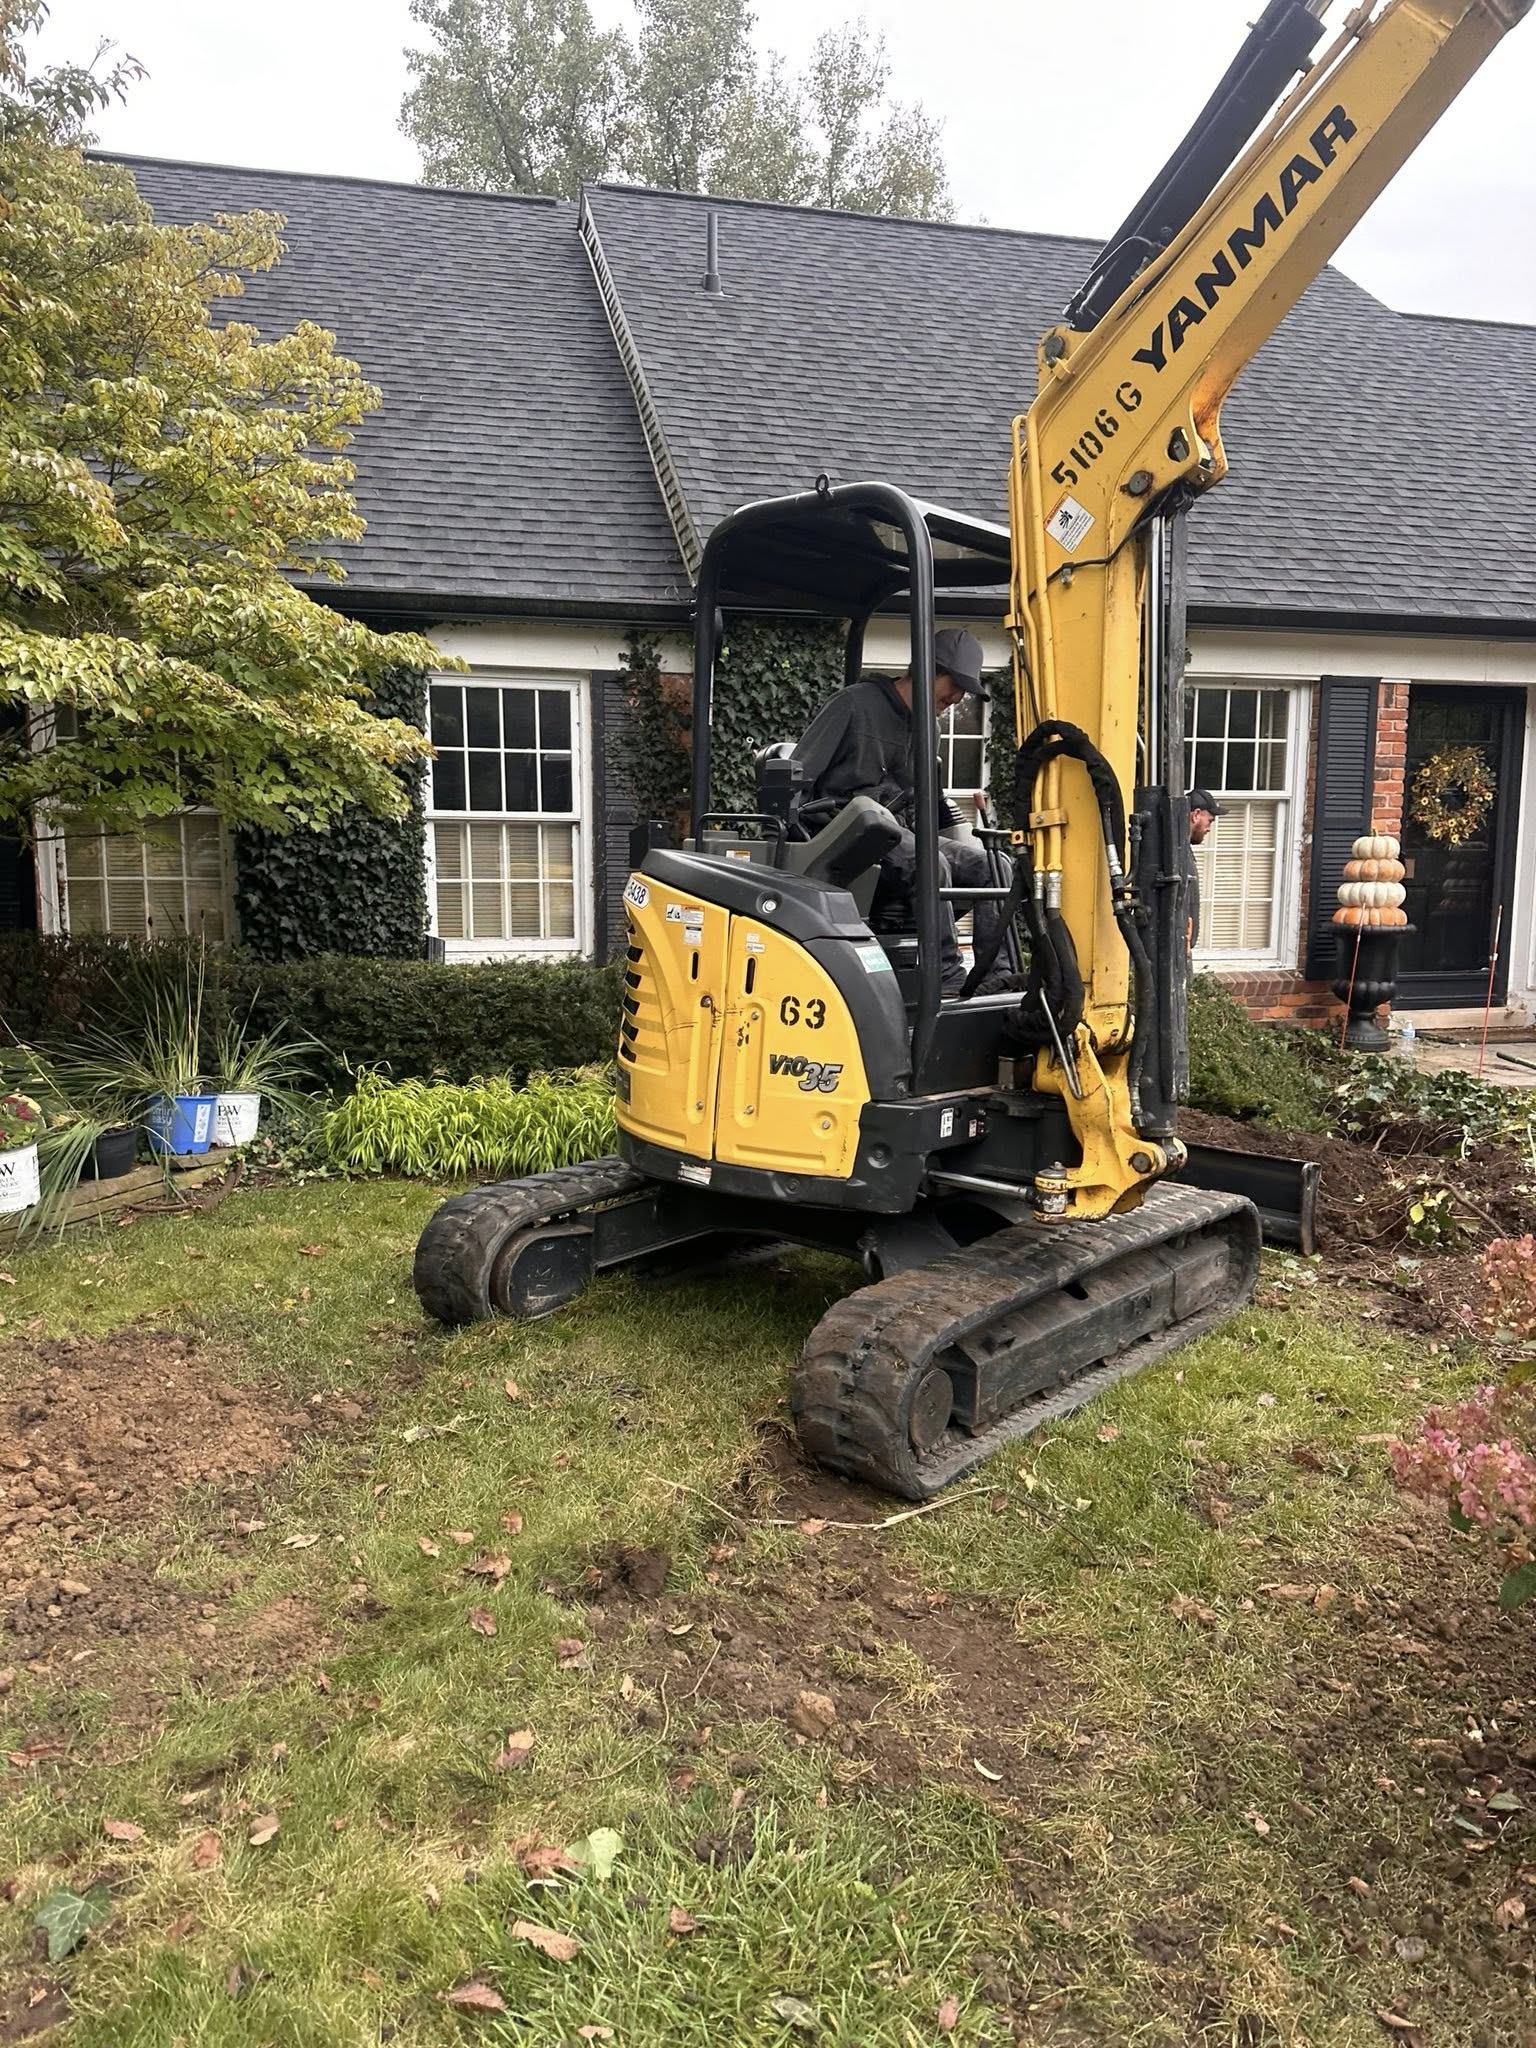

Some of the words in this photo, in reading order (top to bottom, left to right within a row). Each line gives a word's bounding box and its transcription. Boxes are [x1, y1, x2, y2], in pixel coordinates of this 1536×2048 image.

[1131, 104, 1358, 373] YANMAR
[1050, 409, 1120, 486] 5106
[1115, 381, 1143, 413] G
[780, 995, 827, 1030] 63
